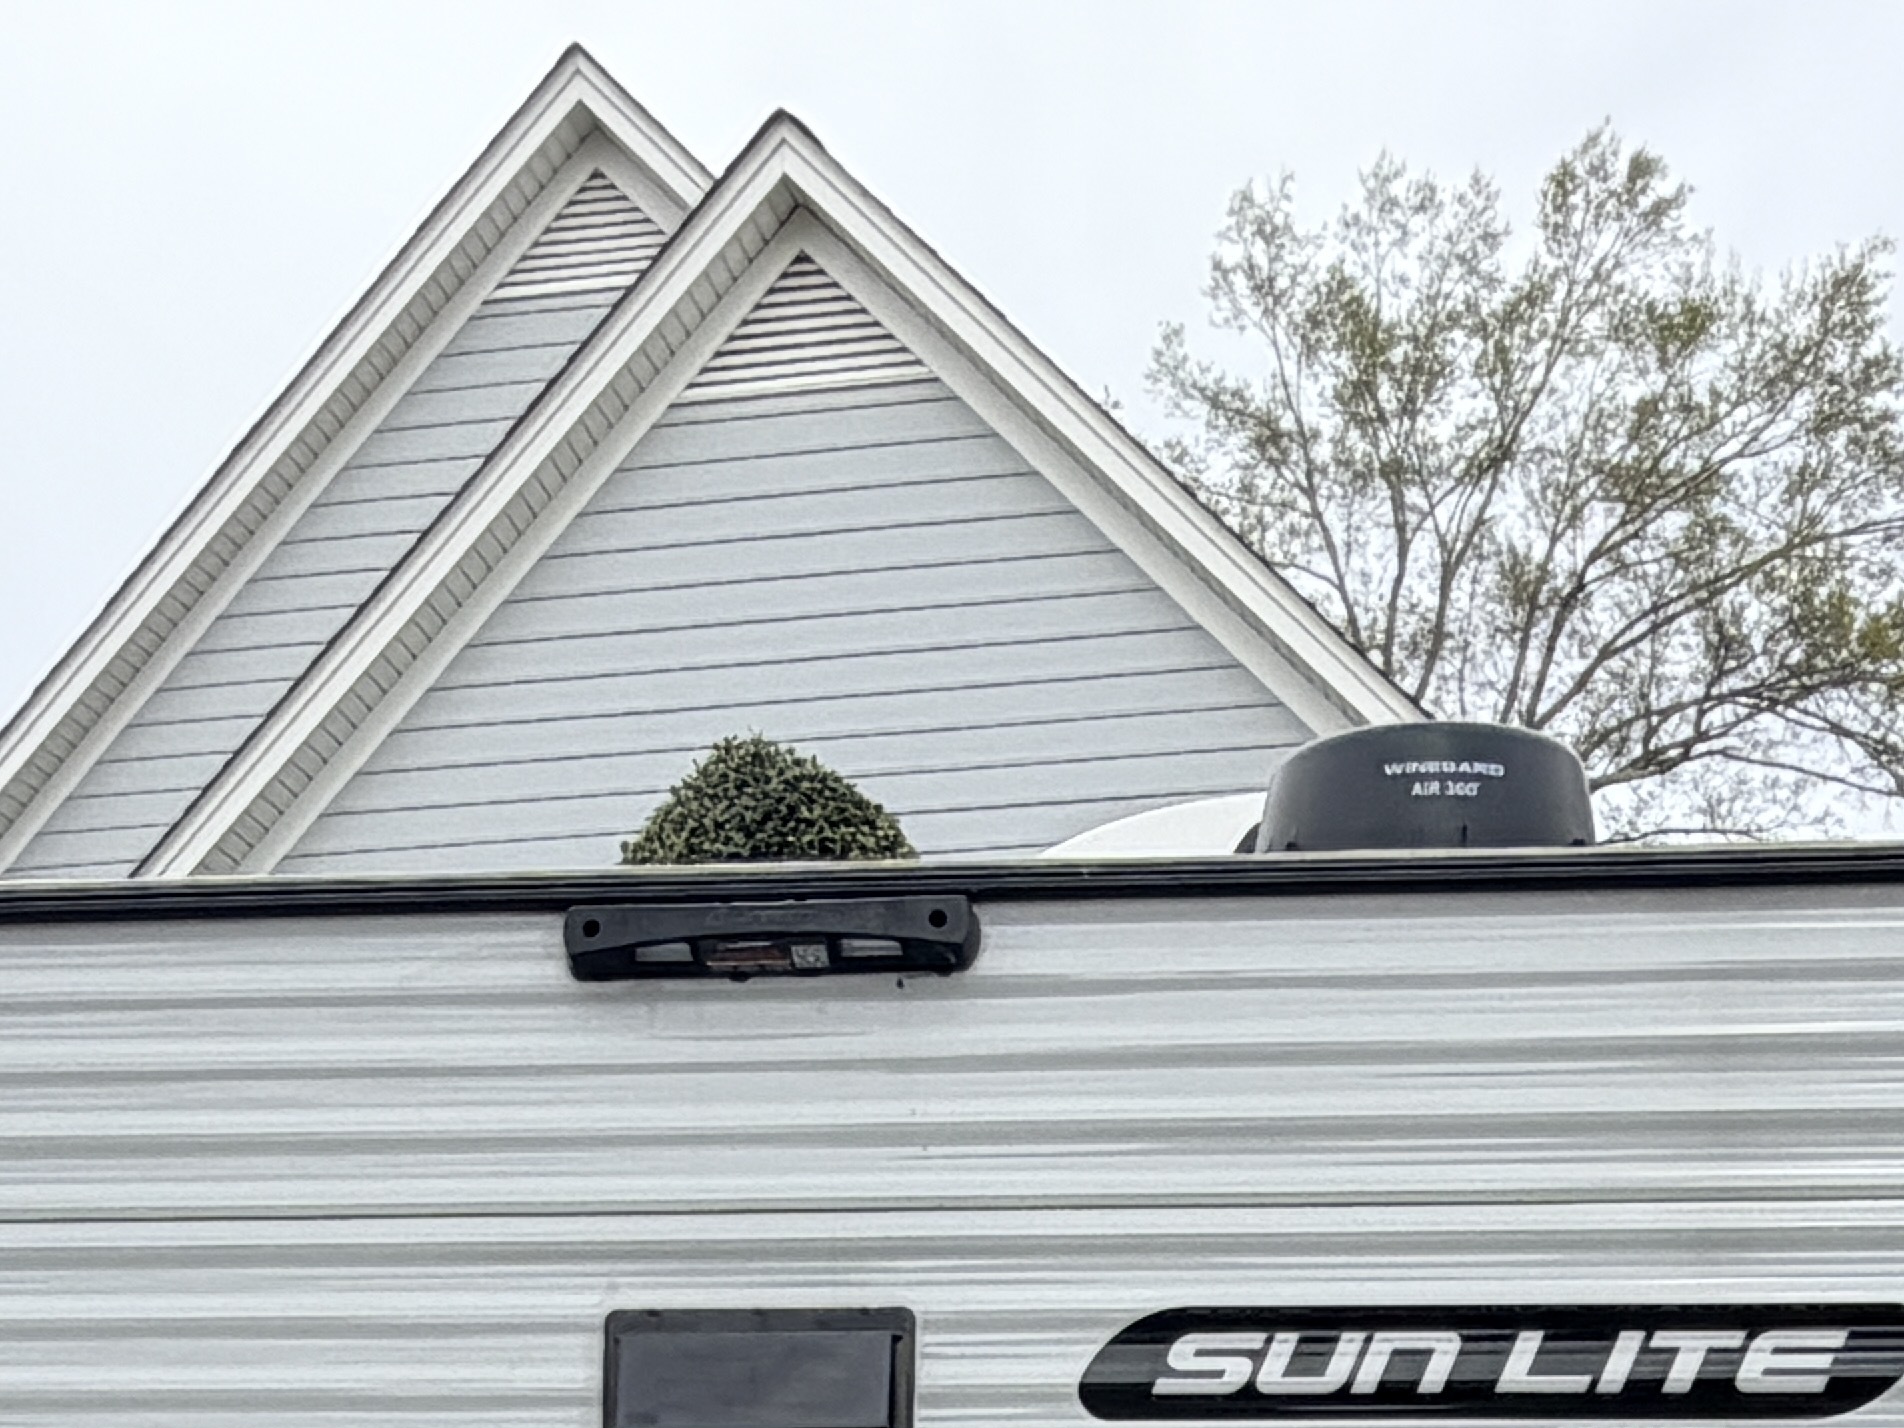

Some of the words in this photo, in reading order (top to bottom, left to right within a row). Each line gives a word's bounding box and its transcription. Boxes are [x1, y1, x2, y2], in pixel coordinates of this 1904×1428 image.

[1411, 780, 1440, 796] AIR
[1151, 1330, 1461, 1395] SUN
[1495, 1329, 1848, 1394] LITE
